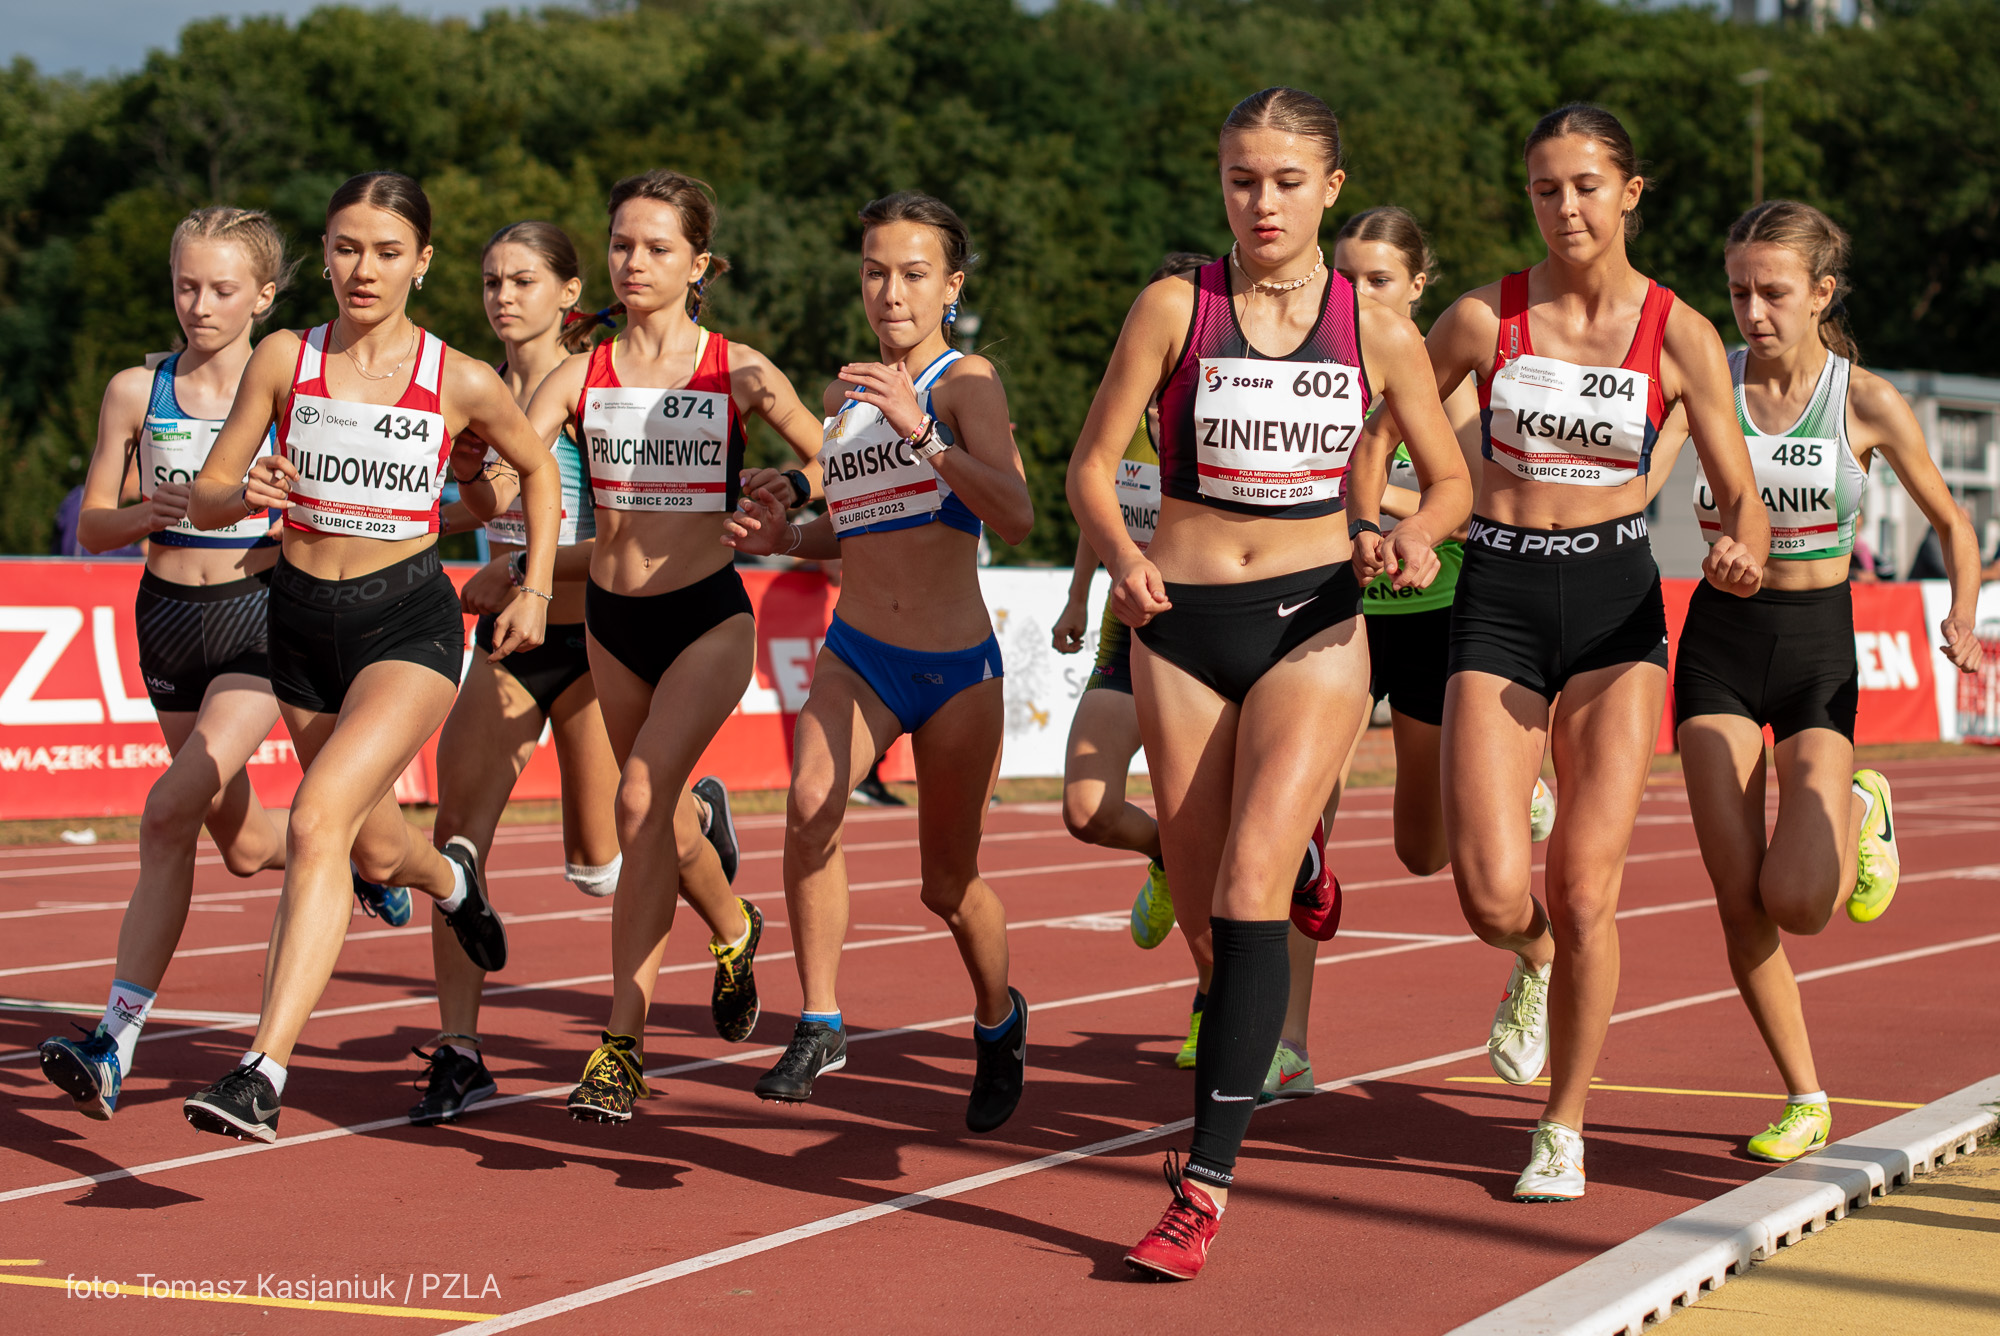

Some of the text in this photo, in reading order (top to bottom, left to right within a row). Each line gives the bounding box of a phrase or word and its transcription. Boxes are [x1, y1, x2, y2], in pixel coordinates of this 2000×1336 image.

[1519, 373, 1537, 381] Sportu
[1521, 366, 1556, 377] Ministerstwo
[1292, 370, 1349, 399] 602
[1580, 373, 1635, 402] 204
[663, 395, 715, 420] 874
[326, 415, 358, 427] Okęcie
[374, 413, 430, 442] 434
[1515, 408, 1613, 447] KSIĄG
[1202, 417, 1356, 453] ZINIEWICZ
[591, 436, 722, 466] PRUCHNIEWICZ
[1771, 443, 1822, 467] 485
[1517, 463, 1600, 480] SŁUBICE 2023
[616, 495, 693, 506] SŁUBICE 2023
[1232, 485, 1313, 499] SŁUBICE 2023
[1700, 485, 1832, 513] UANIK
[312, 514, 396, 534] SŁUBICE 2023
[839, 502, 905, 525] SŁUBICE 2023
[1519, 532, 1600, 556] PRO
[1777, 539, 1806, 549] 2023
[310, 577, 388, 606] PRO
[107, 743, 173, 769] LEKK
